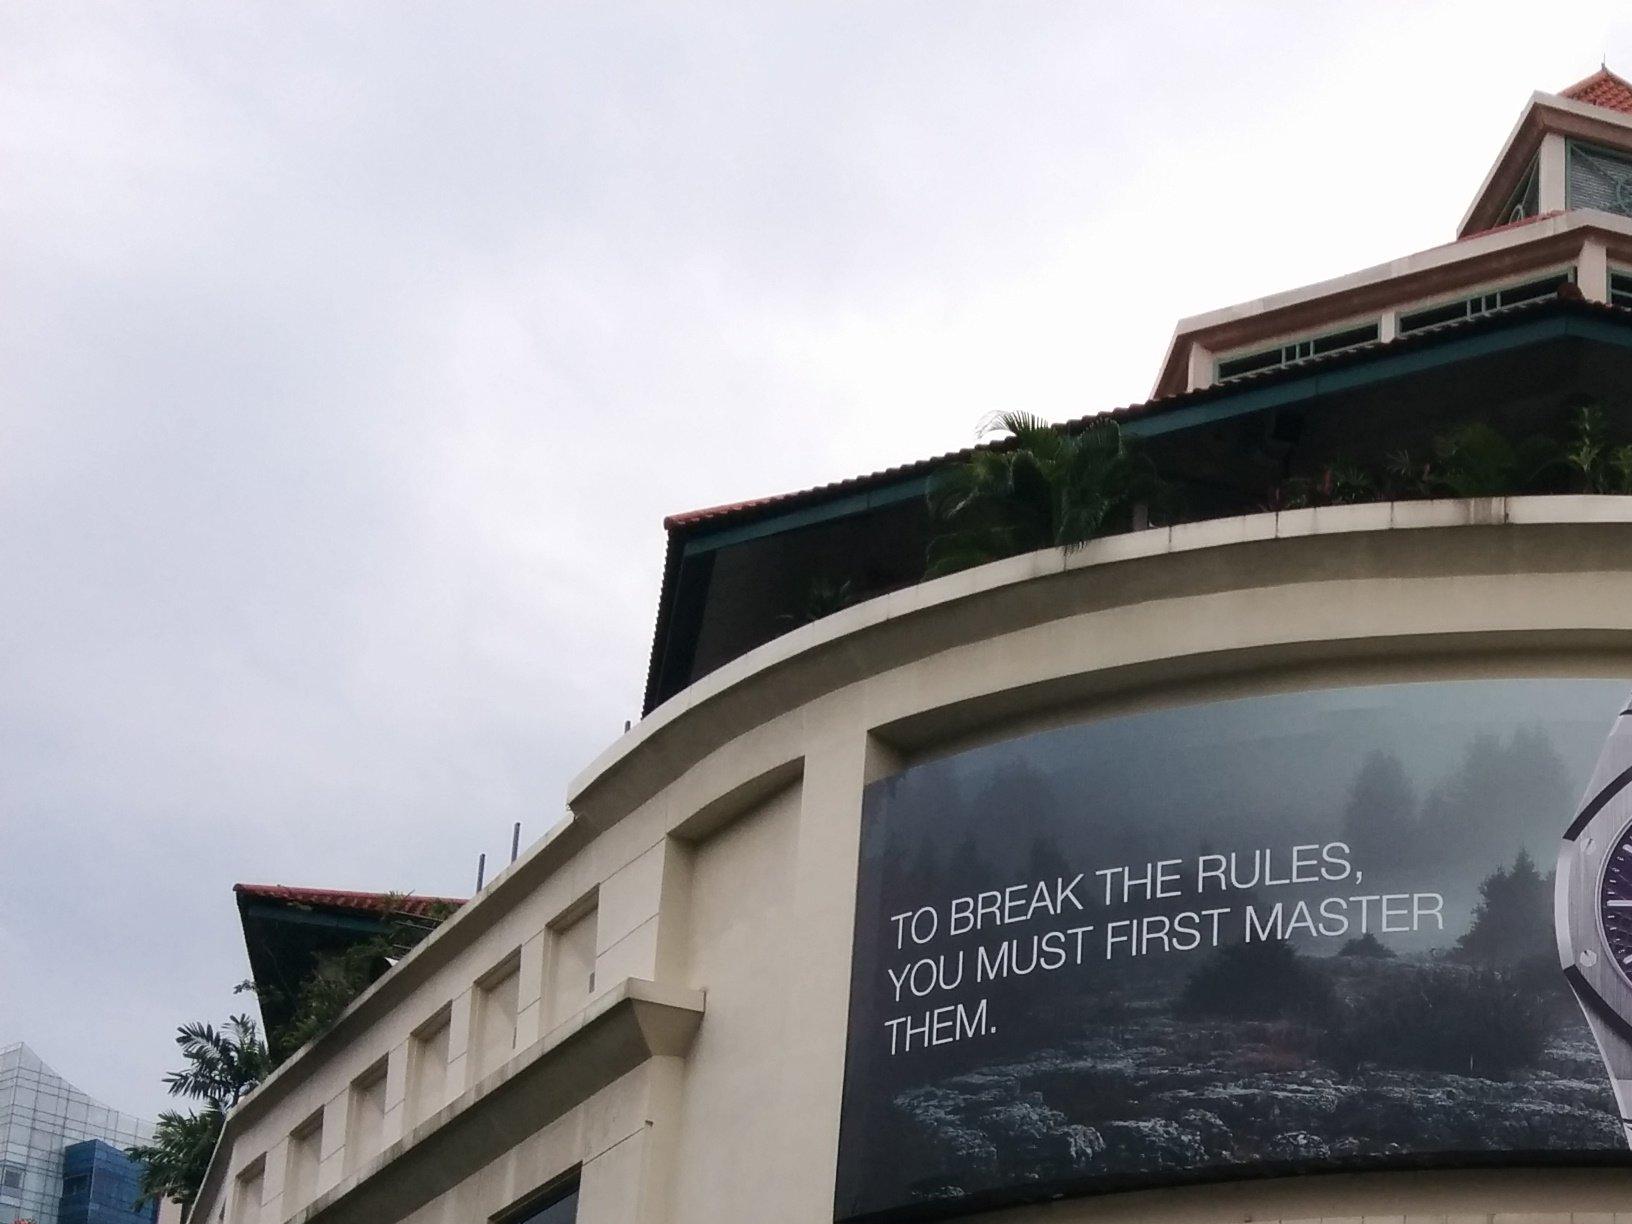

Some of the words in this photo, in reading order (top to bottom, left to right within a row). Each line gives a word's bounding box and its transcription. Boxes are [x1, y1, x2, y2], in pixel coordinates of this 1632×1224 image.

[887, 951, 963, 1002] YOU
[976, 926, 1093, 982] MUST
[1106, 908, 1231, 960] FIRST
[1245, 893, 1445, 944] MASTER
[890, 905, 938, 950] TO
[950, 873, 1085, 936] BREAK
[1096, 859, 1182, 905] THE
[1197, 841, 1364, 894] RULES,
[884, 1000, 997, 1056] THEM.
